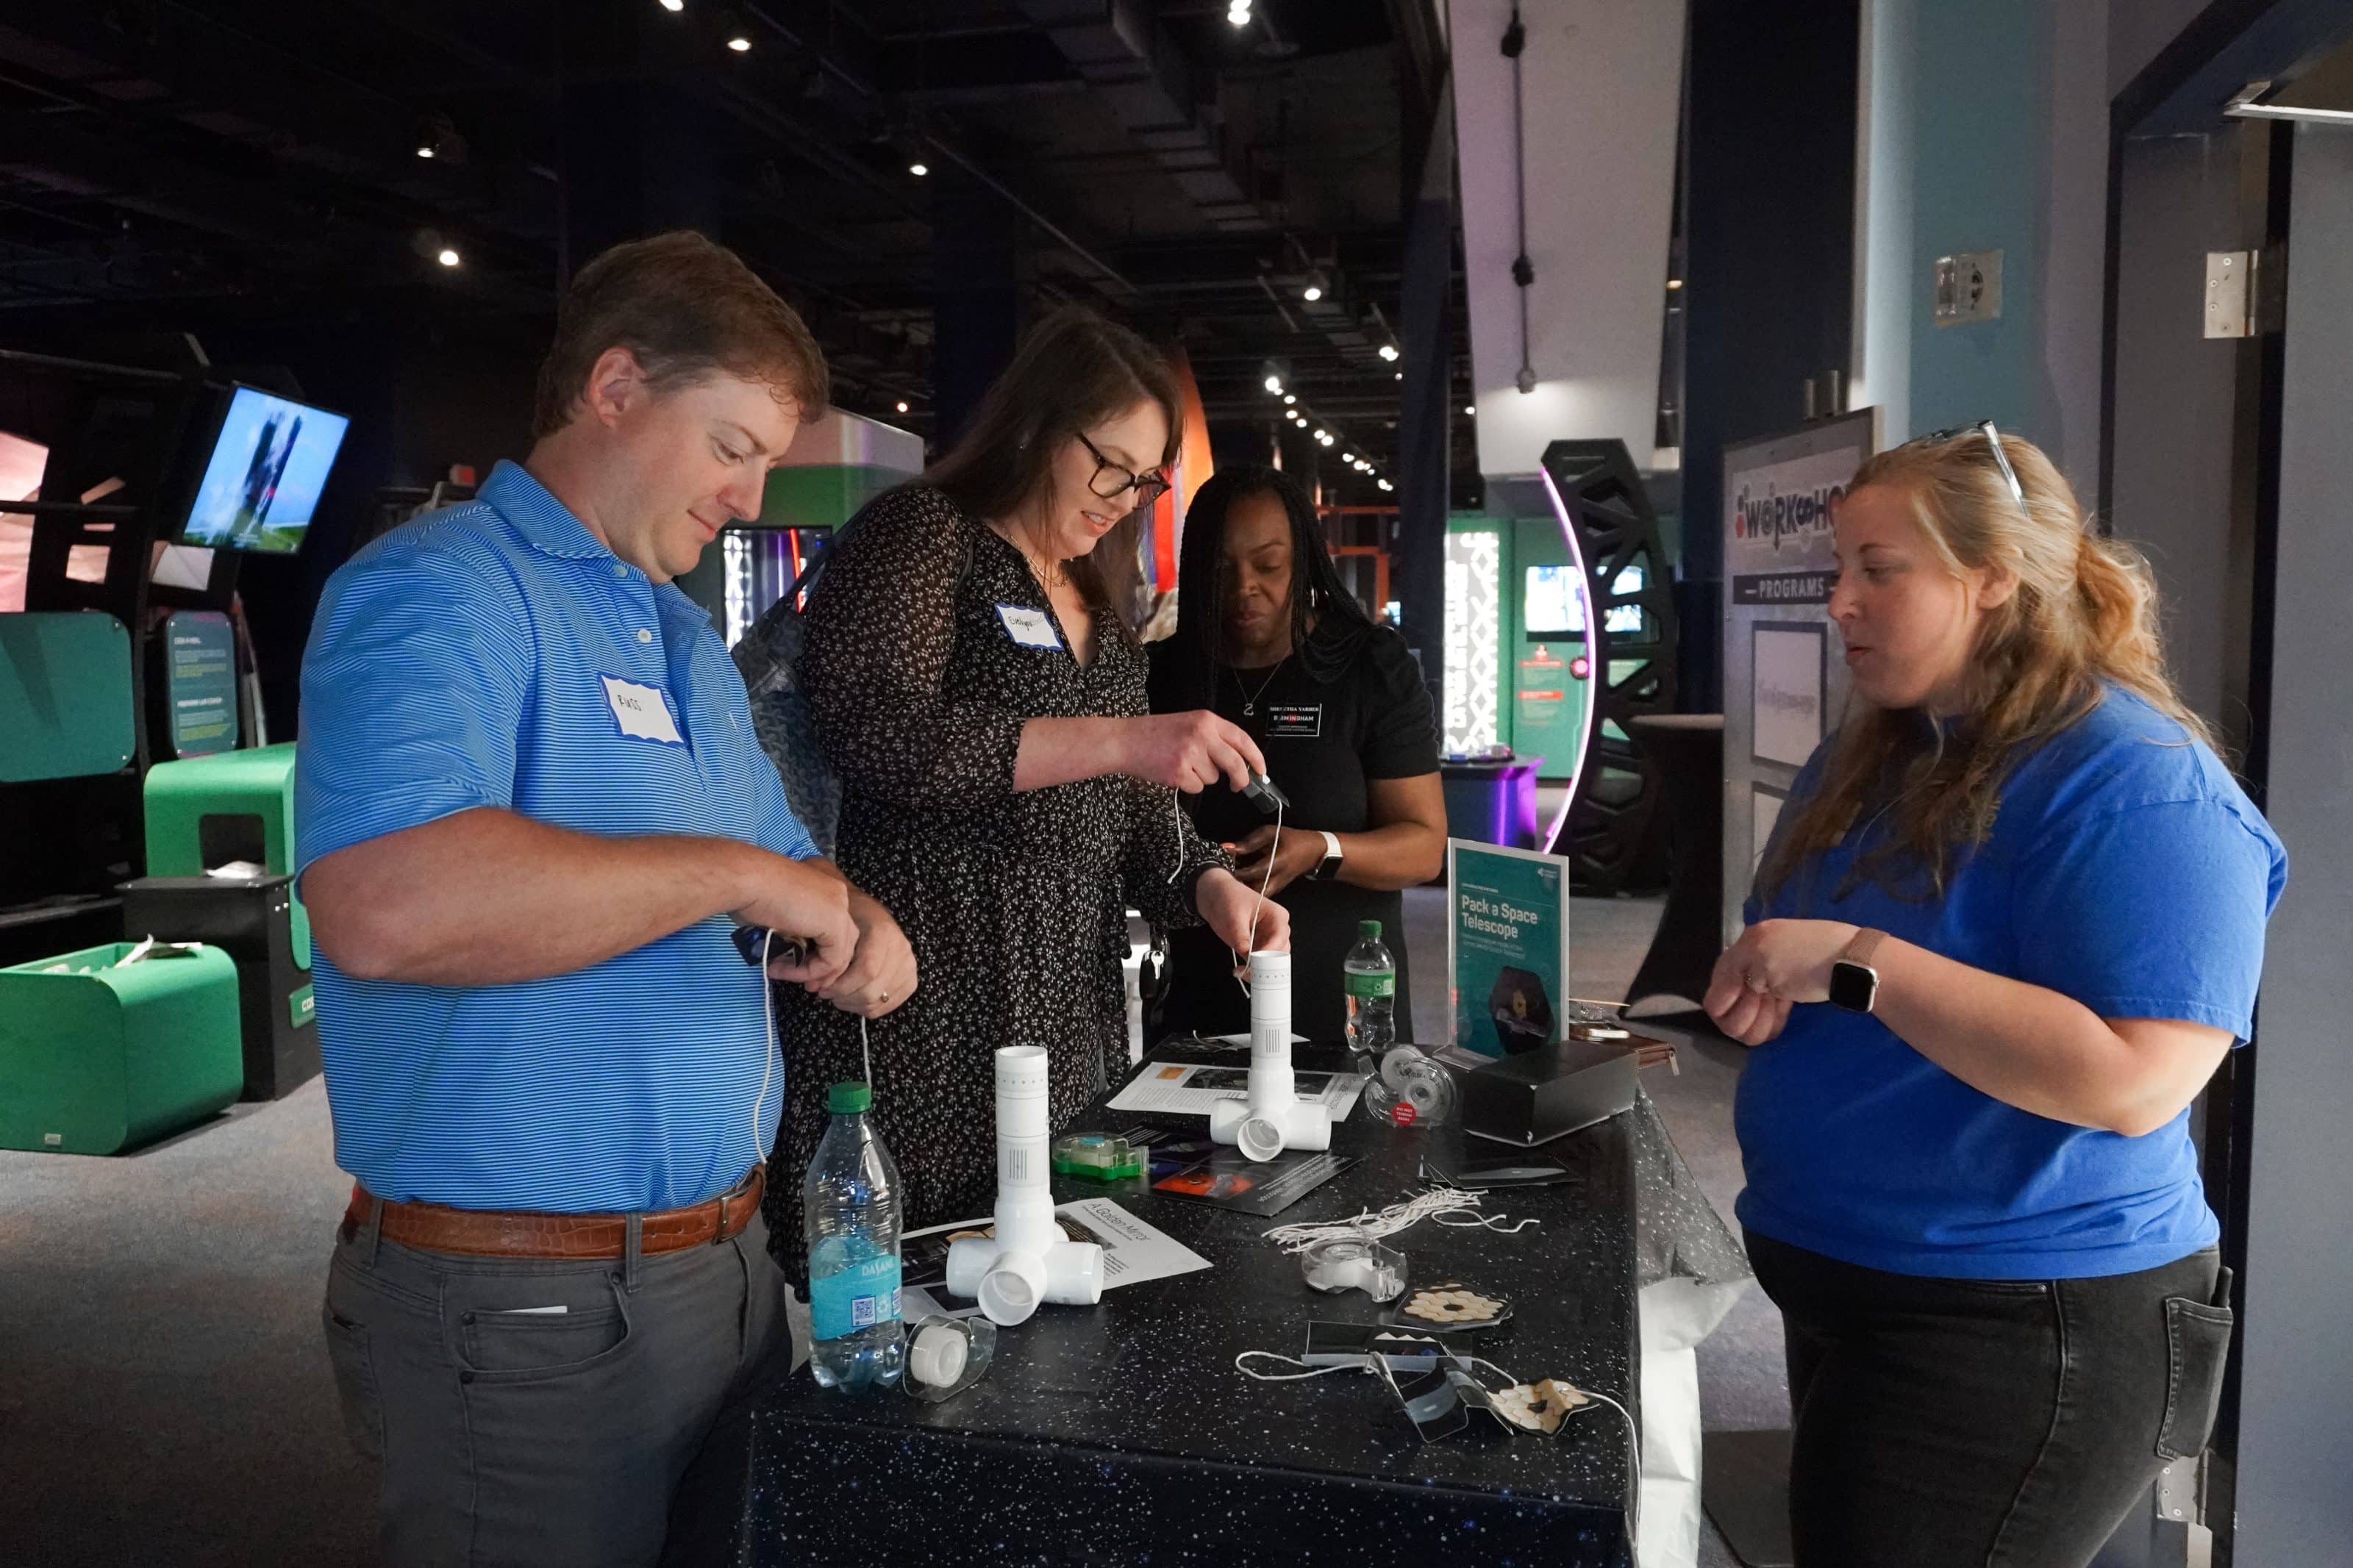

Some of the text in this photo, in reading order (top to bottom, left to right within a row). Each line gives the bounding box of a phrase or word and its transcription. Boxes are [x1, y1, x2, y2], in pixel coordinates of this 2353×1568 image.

[1759, 577, 1824, 598] PROGRAMS
[1462, 895, 1538, 925] Pack a Space
[1462, 912, 1518, 940] Telescope
